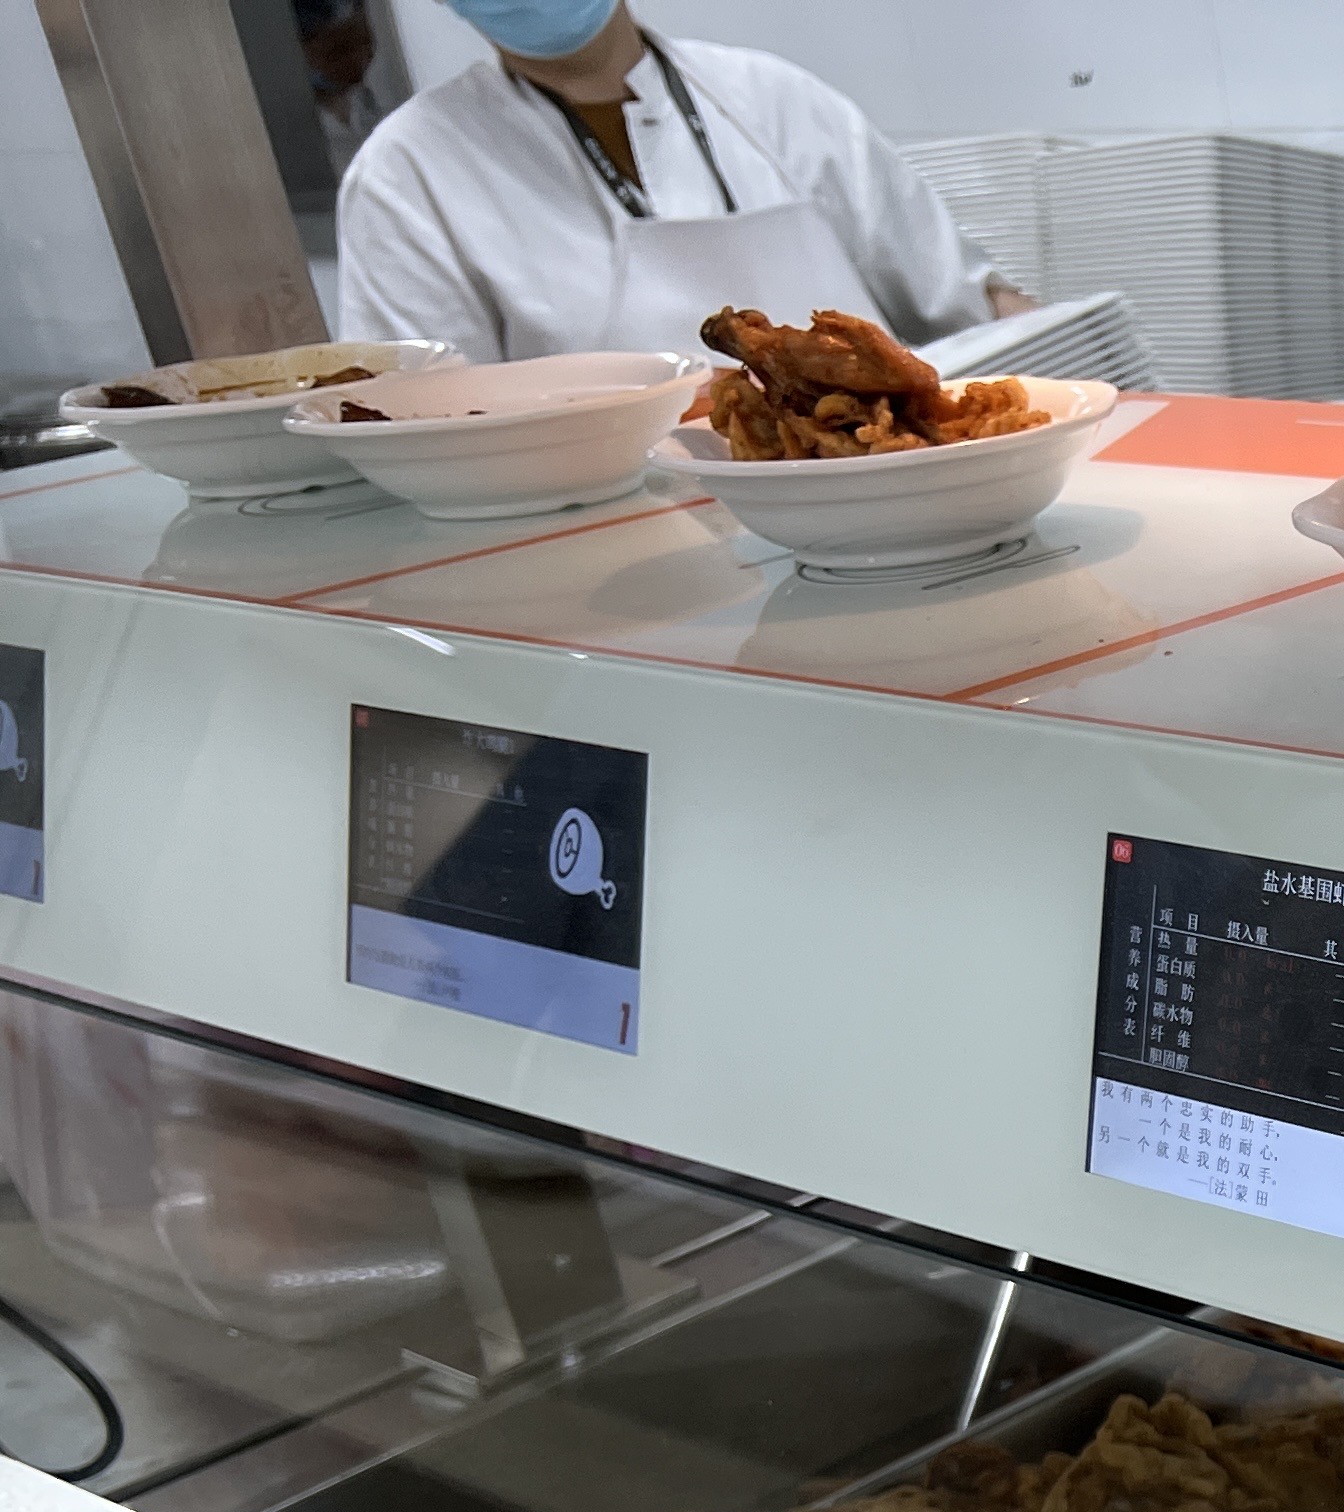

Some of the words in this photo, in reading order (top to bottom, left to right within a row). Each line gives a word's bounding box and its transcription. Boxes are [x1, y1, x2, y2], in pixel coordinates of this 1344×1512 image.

[1159, 908, 1199, 932] 项目
[1226, 920, 1269, 946] 摄入量
[1157, 931, 1199, 956] 热量
[1155, 954, 1197, 980] 蛋白质
[1122, 925, 1143, 1037] 营养成分表
[1152, 1001, 1194, 1027] 碳水物
[1150, 1024, 1192, 1049] 纤维
[1149, 1047, 1190, 1073] 胆固醇
